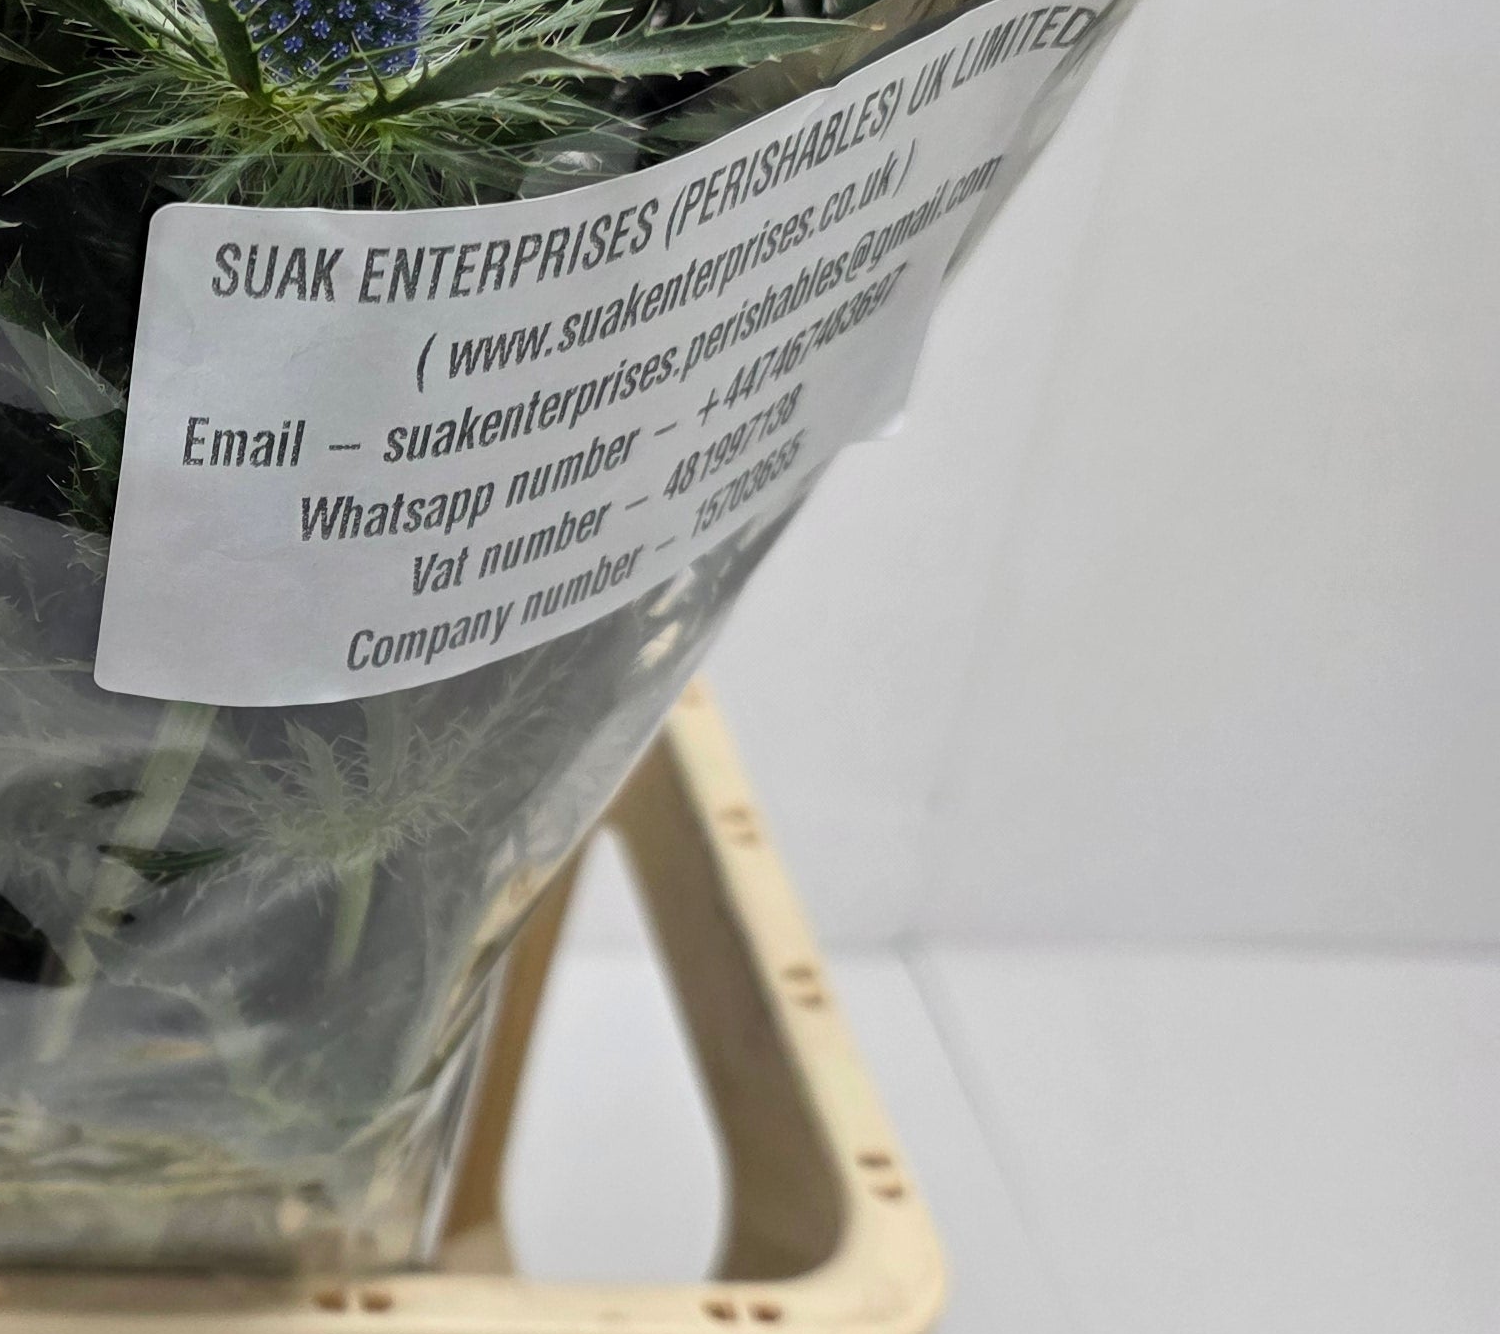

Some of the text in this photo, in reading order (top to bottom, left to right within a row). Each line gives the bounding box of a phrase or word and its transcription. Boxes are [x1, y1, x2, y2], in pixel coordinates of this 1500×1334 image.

[211, 5, 1100, 304] SUAK ENTERPRISES (PERISHABLES) UK LIMITED
[181, 416, 307, 468] Email
[382, 155, 1005, 464] suakenterprises.perishables@gmail.com
[448, 156, 908, 380] www.suakenterprises.co.uk
[300, 481, 495, 541] Whatsapp
[504, 427, 642, 508] number
[411, 546, 469, 596] Vat
[477, 499, 612, 581] number
[346, 599, 516, 672] Company
[519, 544, 644, 625] number
